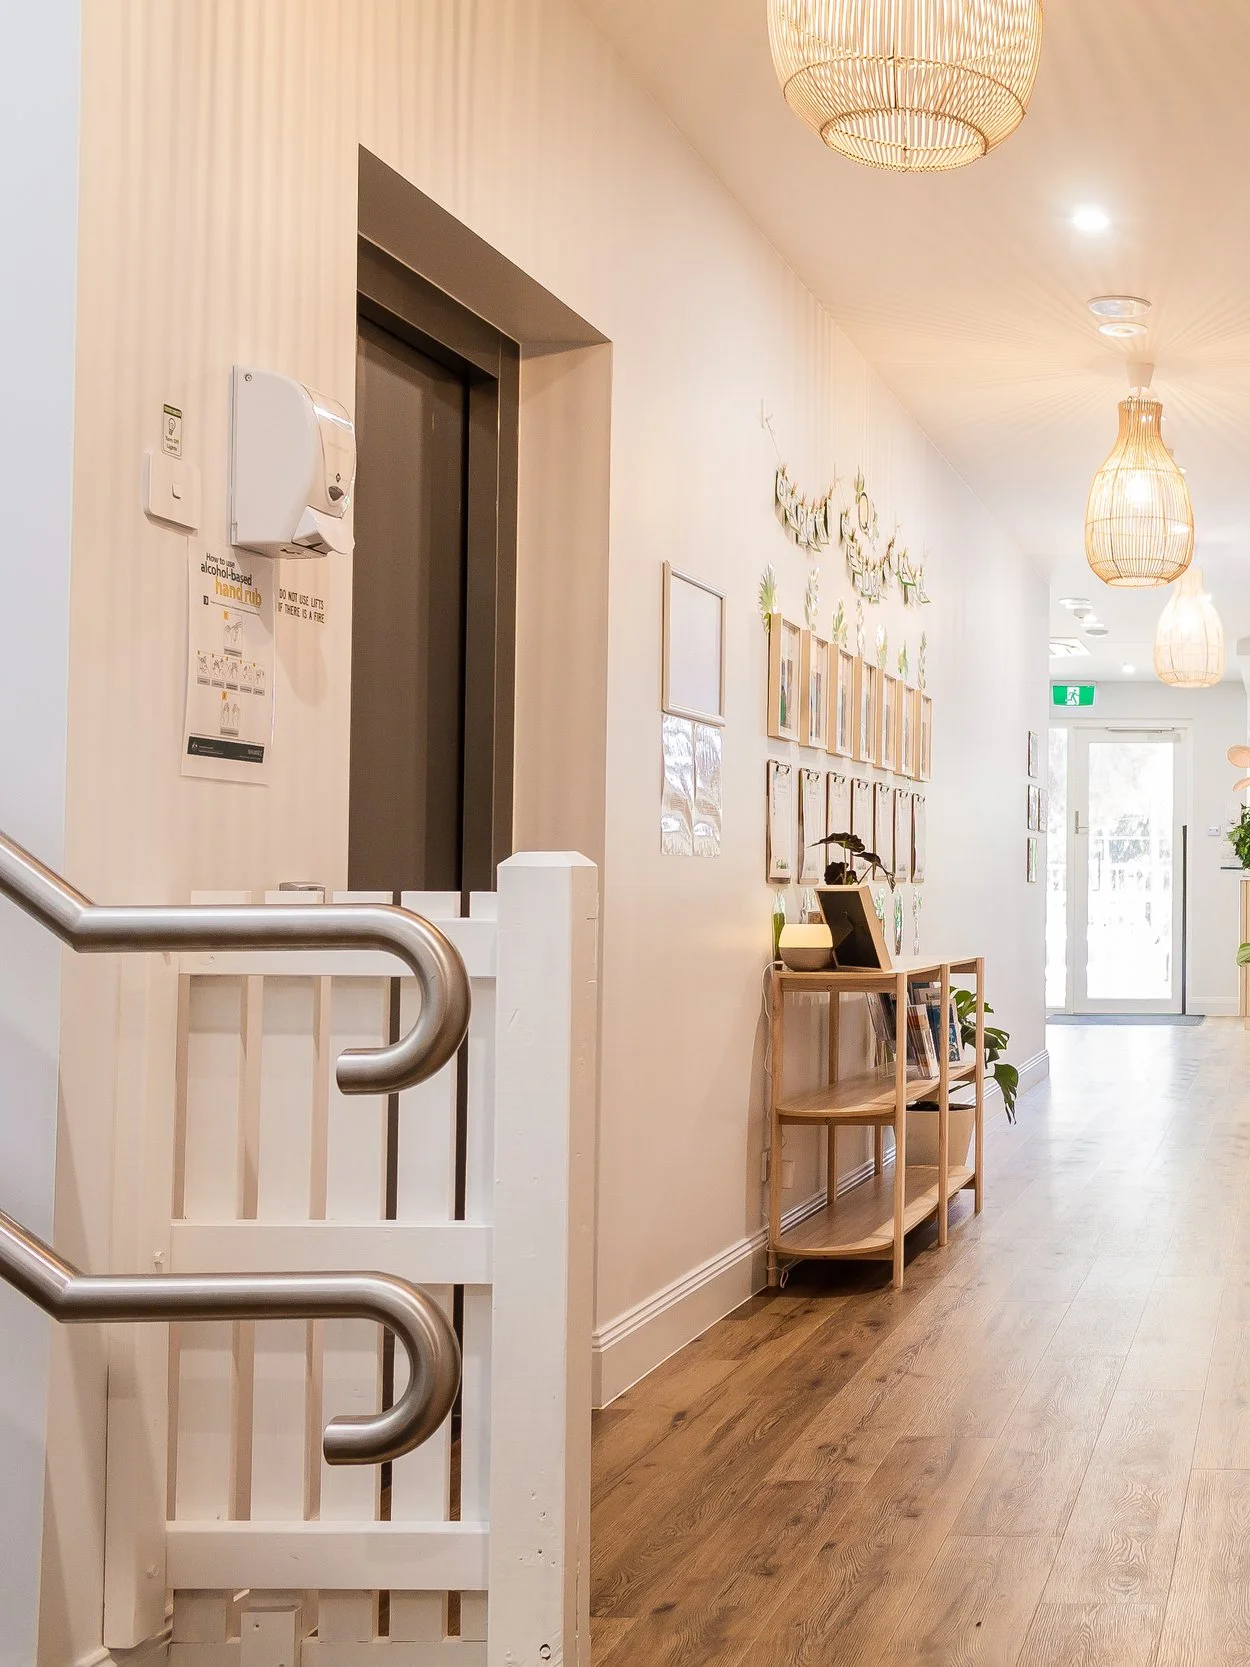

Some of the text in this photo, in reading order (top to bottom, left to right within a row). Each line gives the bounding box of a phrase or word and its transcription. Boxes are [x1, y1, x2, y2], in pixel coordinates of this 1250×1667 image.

[206, 552, 235, 568] How to use
[200, 561, 252, 586] alcohol-based
[215, 576, 262, 607] hand rub
[279, 588, 324, 610] DO NOT USE LIFTS
[278, 602, 283, 612] IF
[285, 603, 301, 617] THERE
[302, 609, 307, 619] IS
[314, 612, 325, 624] FIRE
